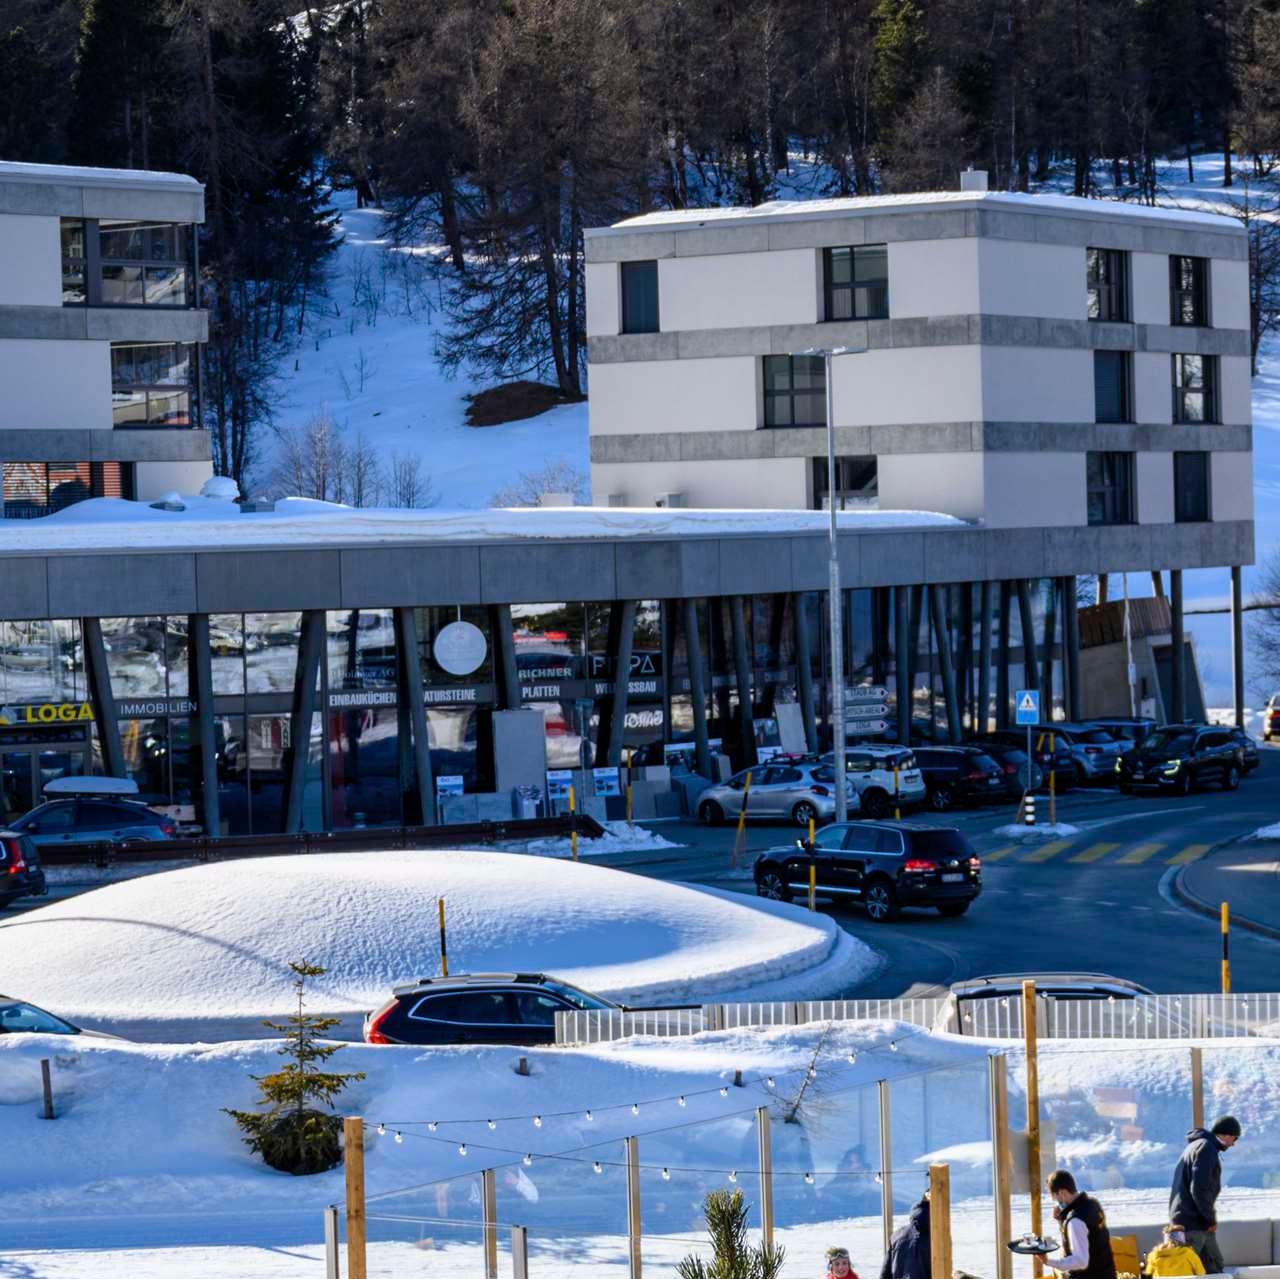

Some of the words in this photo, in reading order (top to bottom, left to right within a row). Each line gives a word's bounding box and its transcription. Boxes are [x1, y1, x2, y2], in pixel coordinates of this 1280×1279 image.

[329, 690, 397, 706] EINBAUKÜCHEN
[424, 688, 476, 702] ATURSTEINE
[522, 685, 560, 698] PLATTEN
[26, 703, 95, 723] LOGA
[120, 702, 197, 715] IMMOBILIEN
